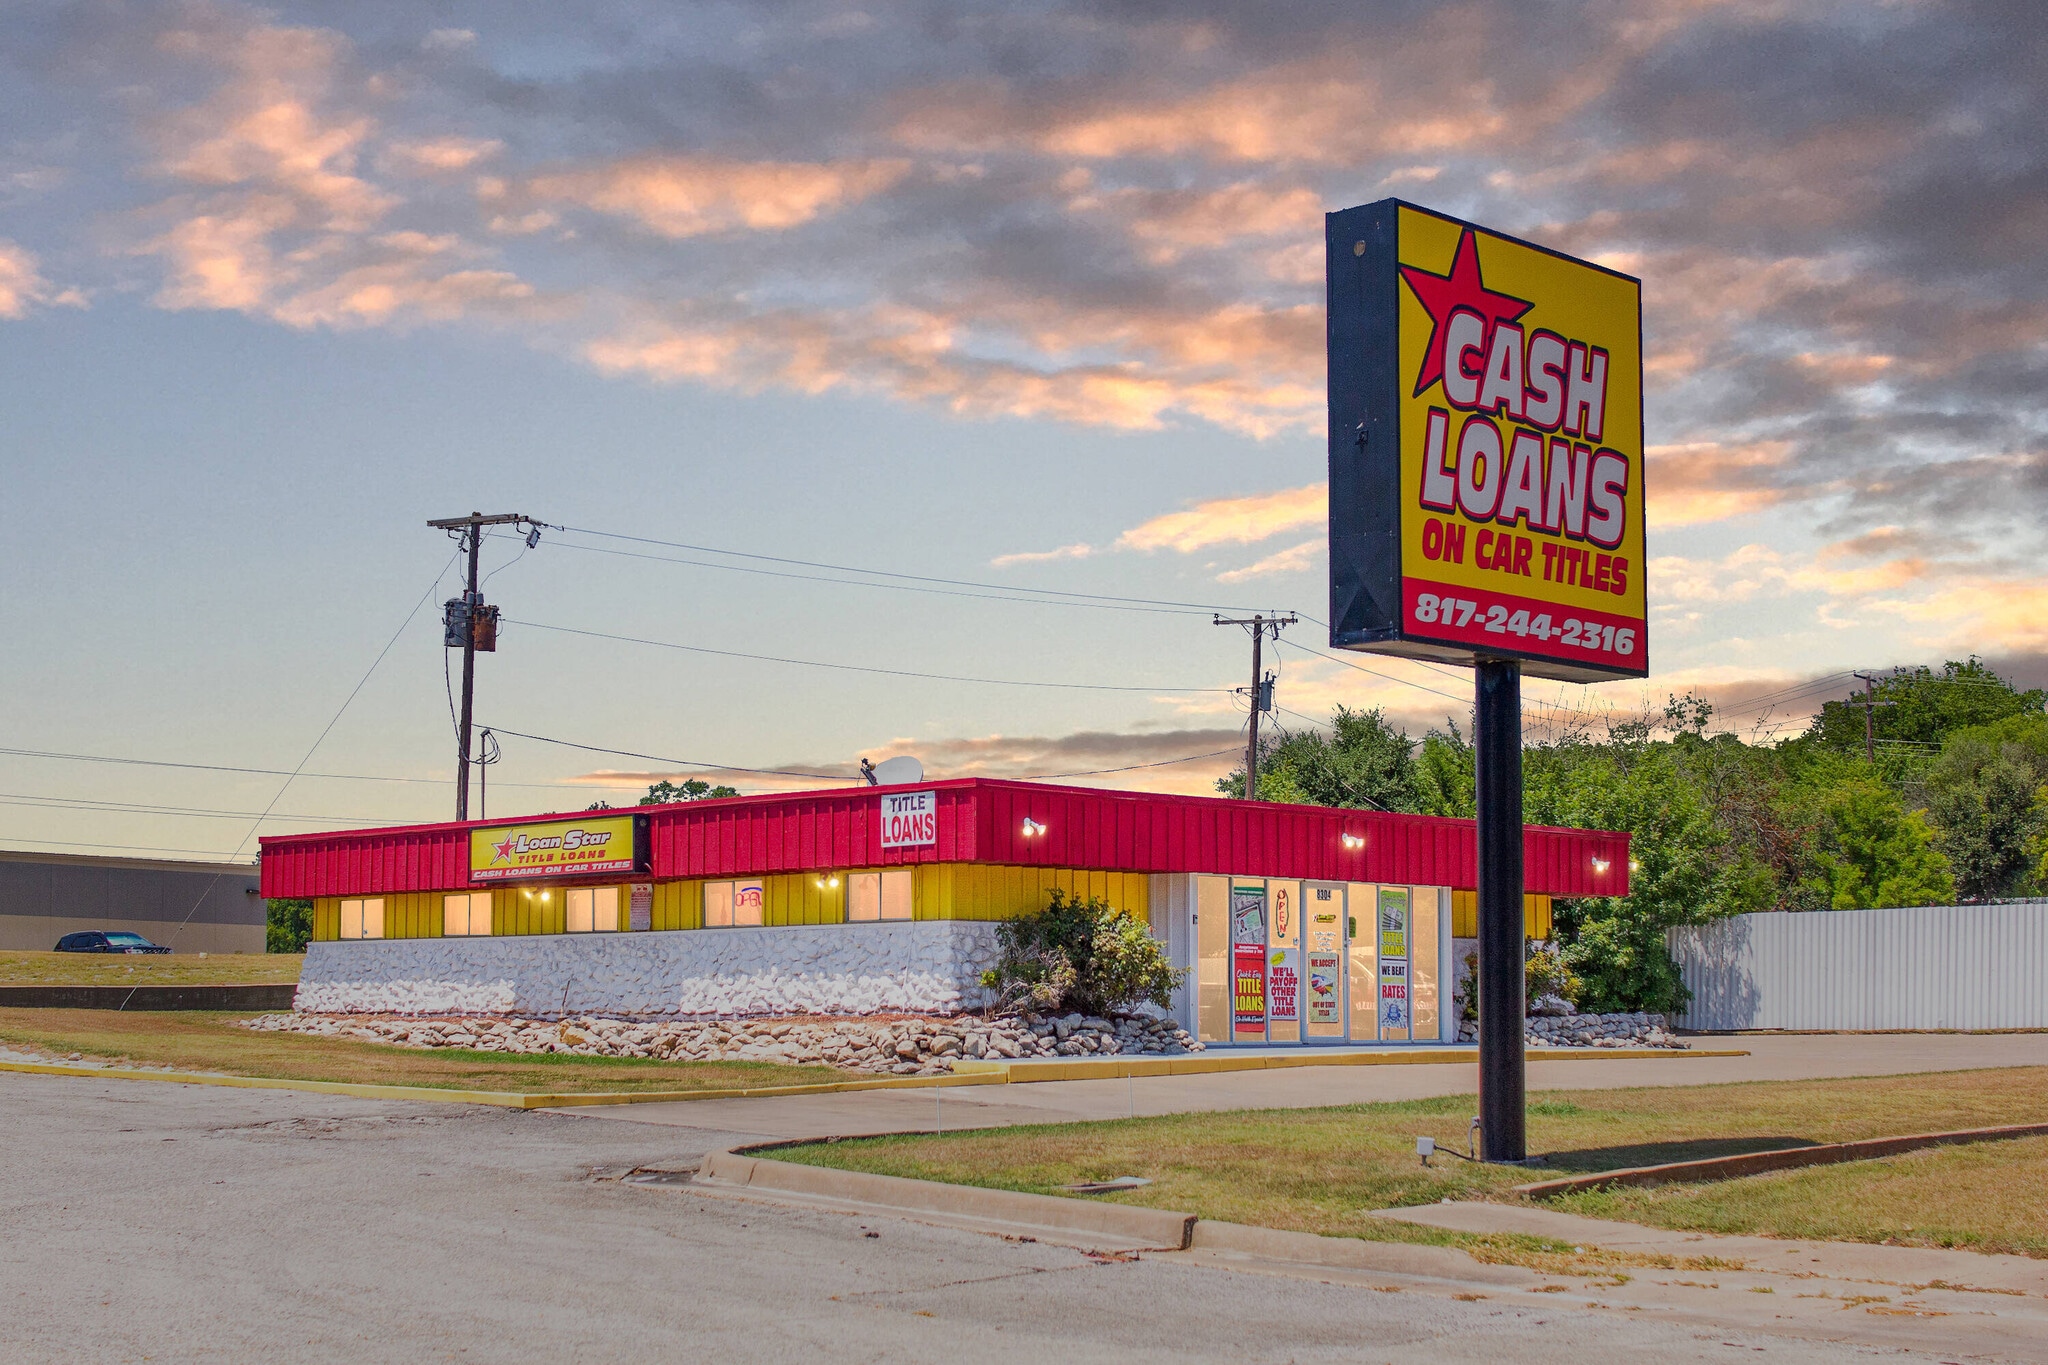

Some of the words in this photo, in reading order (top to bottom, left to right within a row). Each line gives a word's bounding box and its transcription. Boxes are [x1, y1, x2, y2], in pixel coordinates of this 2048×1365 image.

[1442, 304, 1608, 443] CASH
[1420, 406, 1628, 550] LOANS
[1423, 518, 1466, 564] ON
[1475, 529, 1533, 577] CAR
[1542, 541, 1628, 596] TITLES
[1415, 593, 1636, 655] 817-244-2316
[890, 795, 926, 812] TITLE
[883, 813, 934, 843] LOANS
[515, 835, 562, 853] Loan
[563, 830, 611, 850] Star
[518, 854, 553, 864] TITLE
[561, 850, 606, 860] LOANS
[473, 869, 503, 879] CASH
[505, 867, 542, 877] LOANS
[545, 865, 561, 874] ON
[564, 863, 588, 872] CAR
[592, 860, 631, 870] TITLES
[1317, 889, 1331, 900] 8304
[1276, 889, 1287, 933] OPEN
[1382, 931, 1403, 944] TITLE
[1381, 944, 1405, 956] LOANS
[1310, 958, 1319, 968] WE
[1319, 959, 1336, 968] ACCEPT
[1381, 965, 1391, 976] WE
[1391, 966, 1405, 976] BEAT
[1272, 966, 1295, 977] WE'LL
[1237, 978, 1262, 994] TITLE
[1271, 987, 1297, 997] OTHER
[1381, 984, 1406, 999] RATES
[1235, 995, 1264, 1012] LOANS
[1273, 997, 1295, 1006] TITLE
[1271, 1006, 1296, 1016] LOANS
